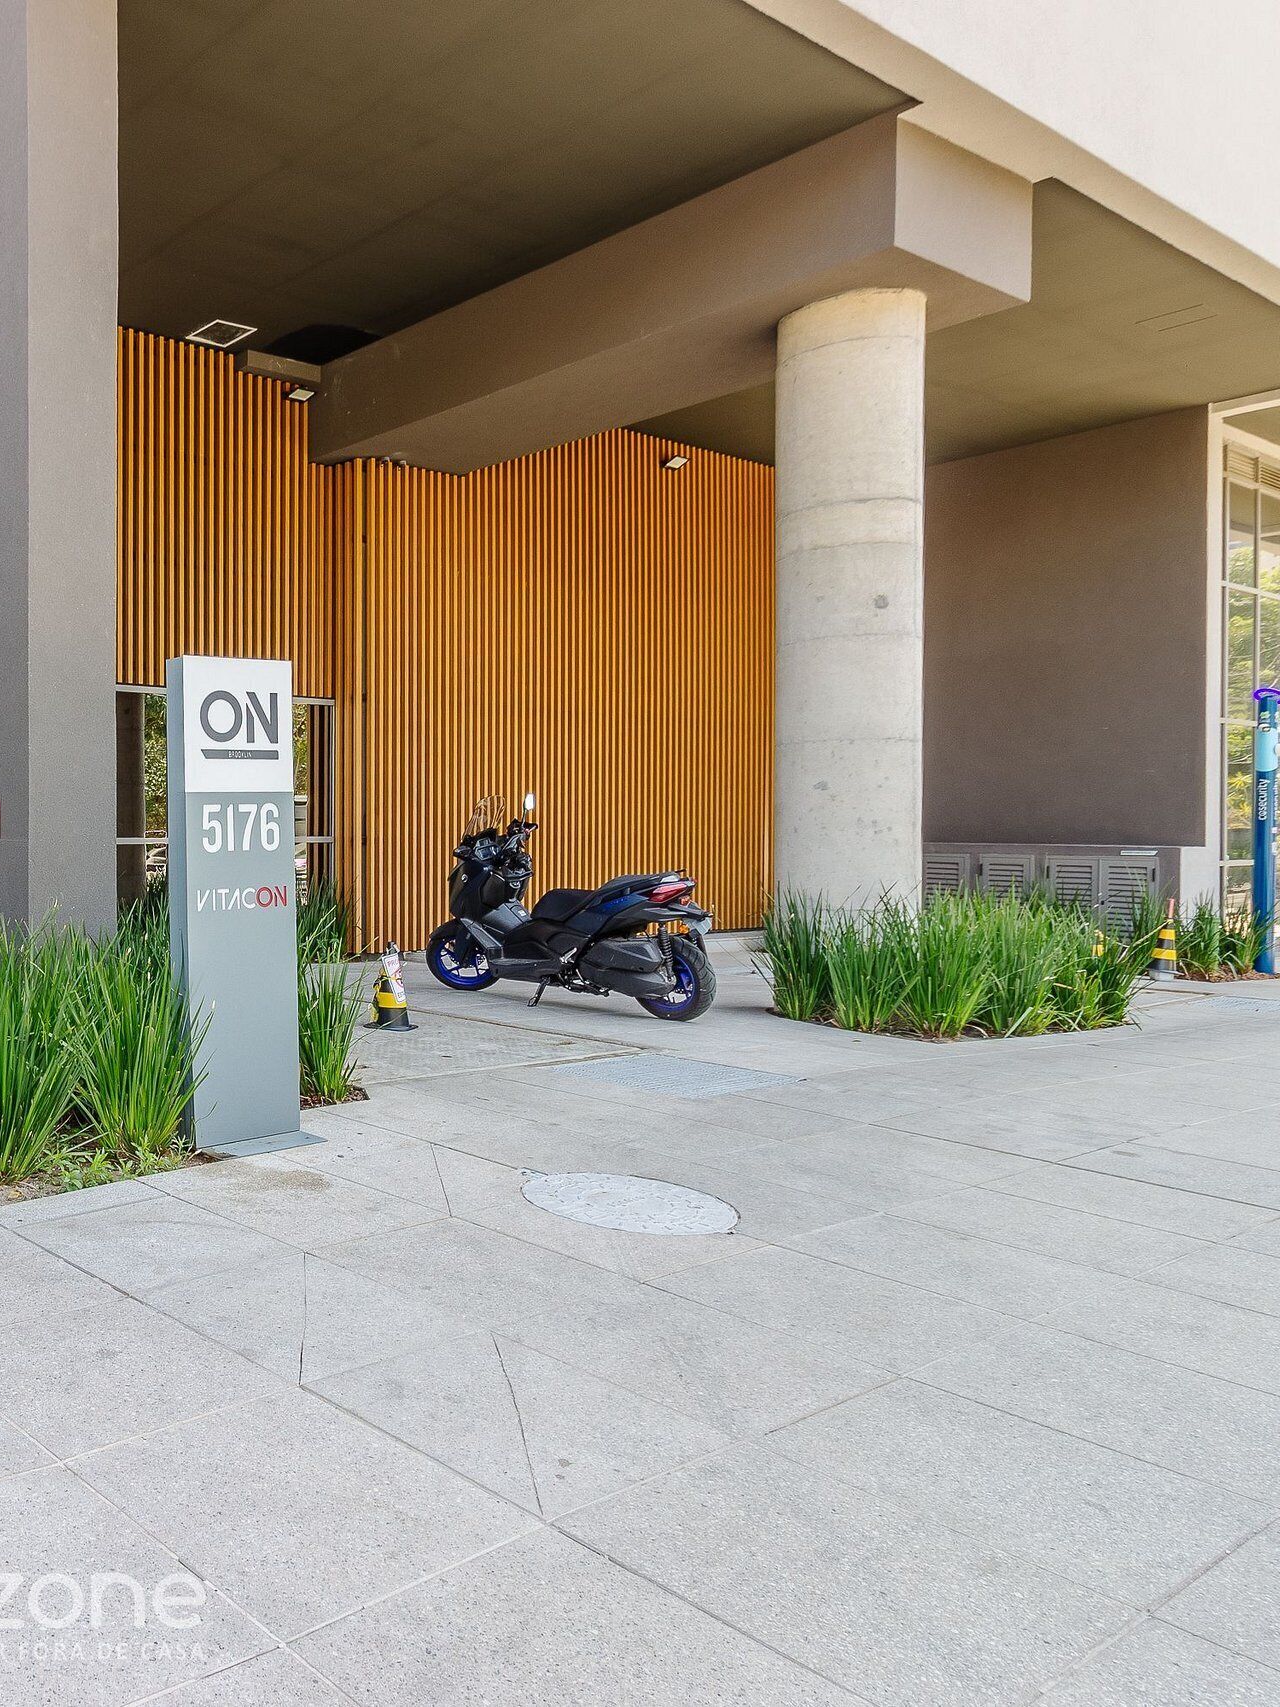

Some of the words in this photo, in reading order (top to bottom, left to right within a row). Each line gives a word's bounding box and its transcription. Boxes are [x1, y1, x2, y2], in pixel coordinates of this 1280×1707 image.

[199, 690, 279, 744] ON
[202, 803, 280, 854] 5176
[197, 885, 288, 912] VITACON
